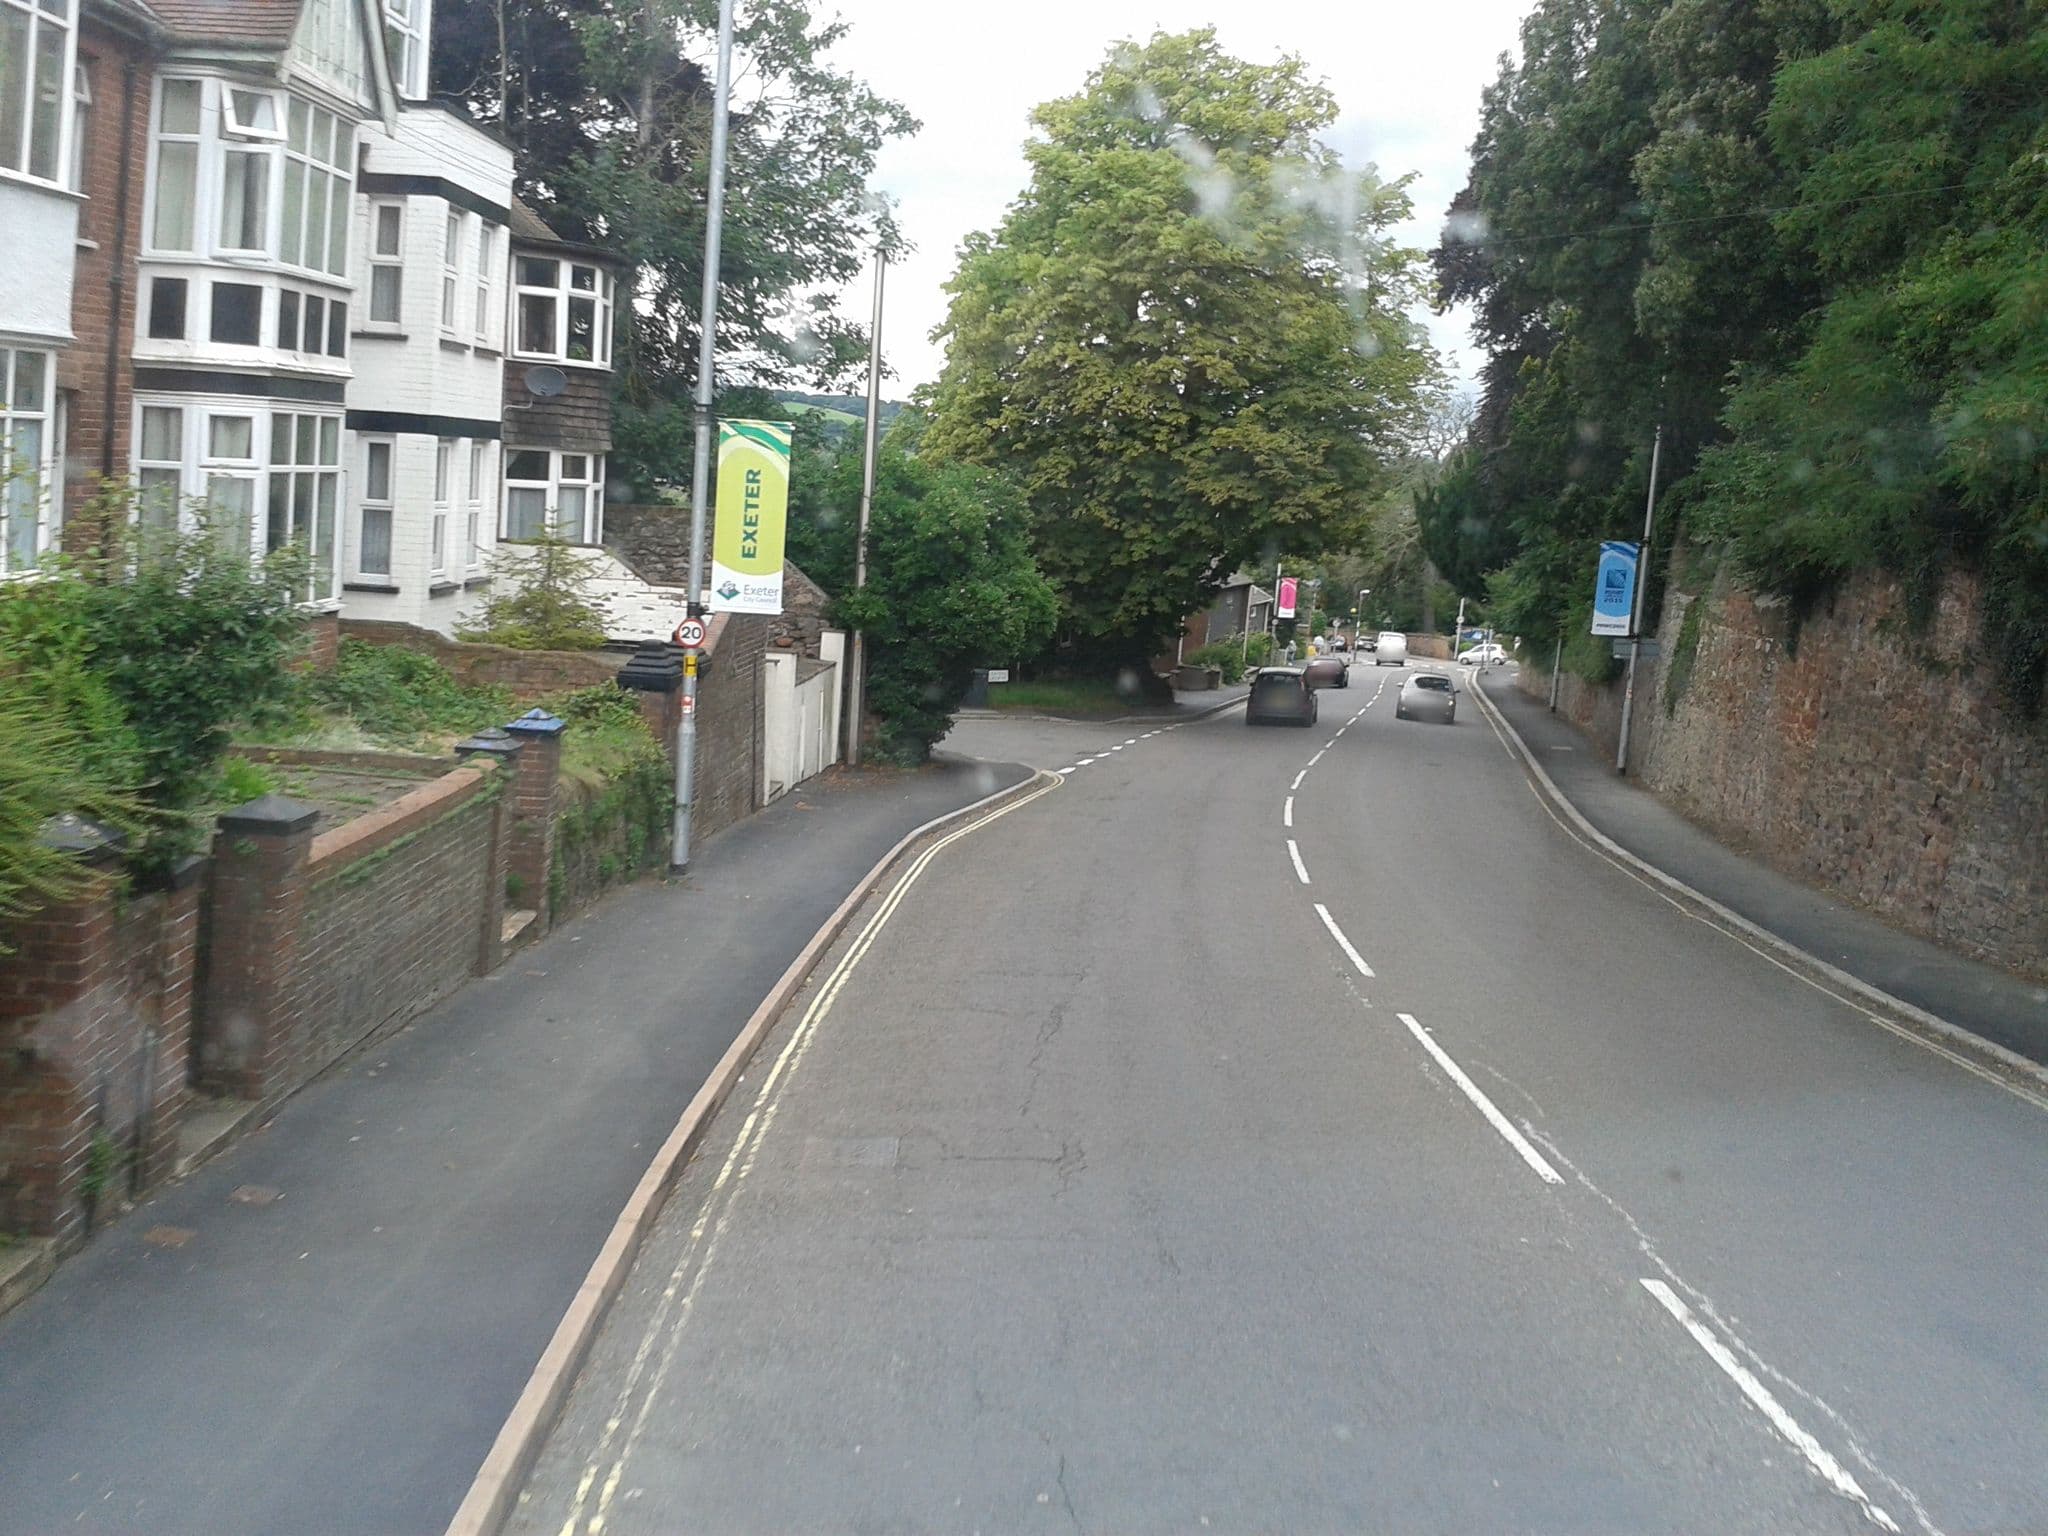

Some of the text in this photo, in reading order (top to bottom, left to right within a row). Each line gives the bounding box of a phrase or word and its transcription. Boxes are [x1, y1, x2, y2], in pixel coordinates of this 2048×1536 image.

[742, 468, 761, 559] EXETER
[743, 584, 779, 596] Exeter
[681, 626, 702, 639] 20
